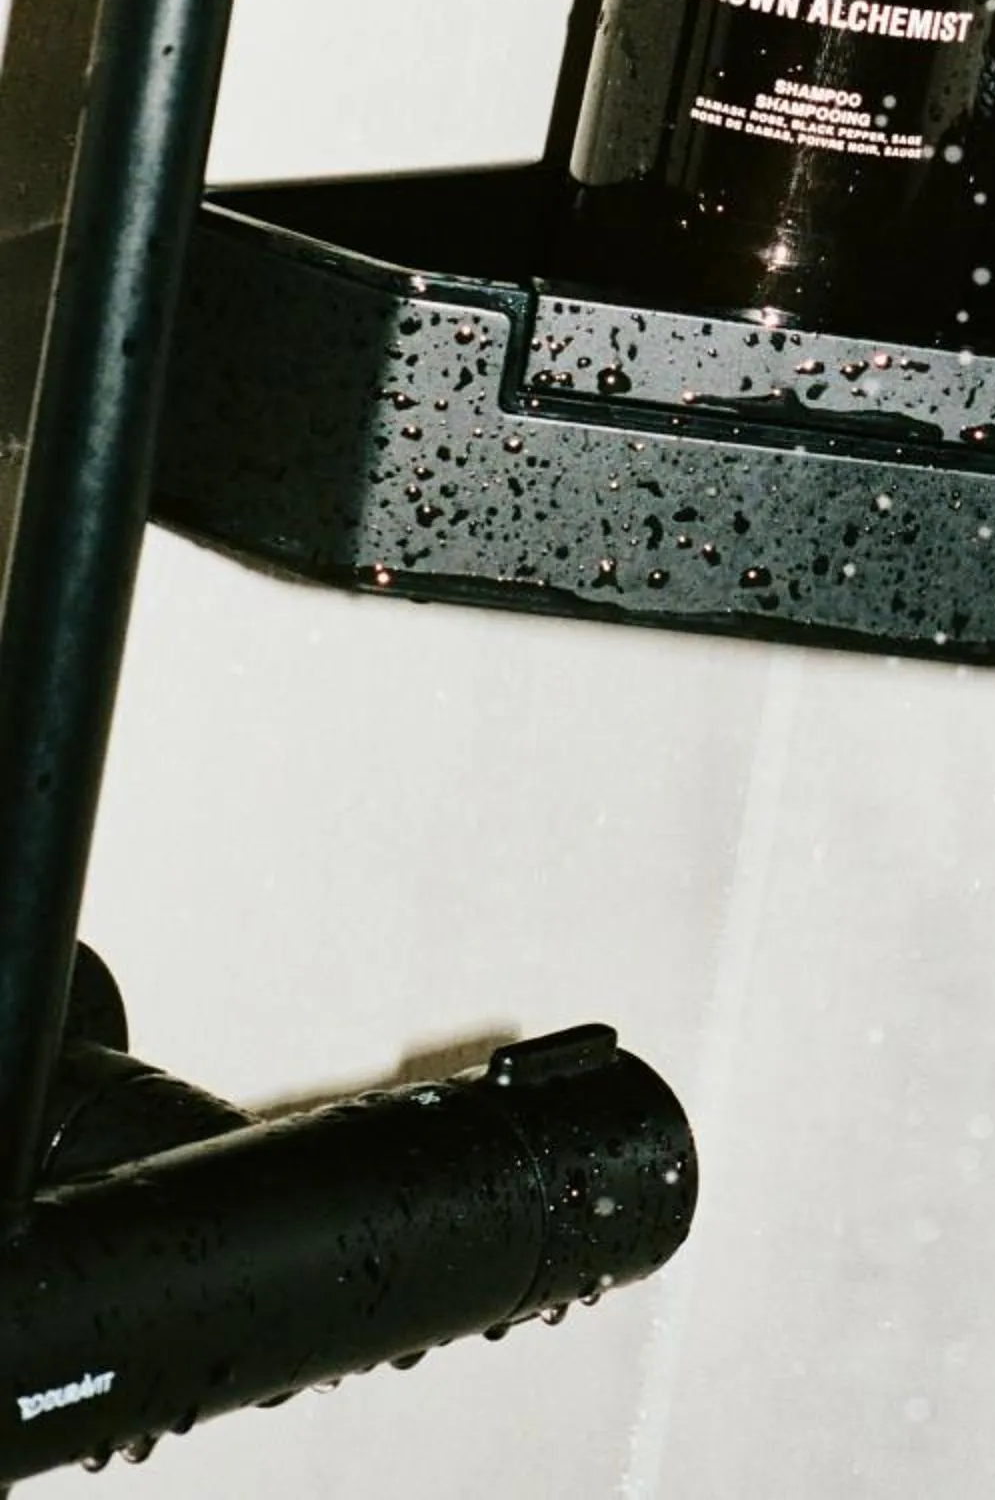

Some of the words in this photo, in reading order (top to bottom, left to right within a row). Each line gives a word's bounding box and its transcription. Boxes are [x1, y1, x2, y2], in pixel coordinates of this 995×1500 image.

[774, 78, 863, 108] SHAMPOO
[755, 93, 871, 127] SHAMPOOING
[791, 118, 835, 137] BLACK
